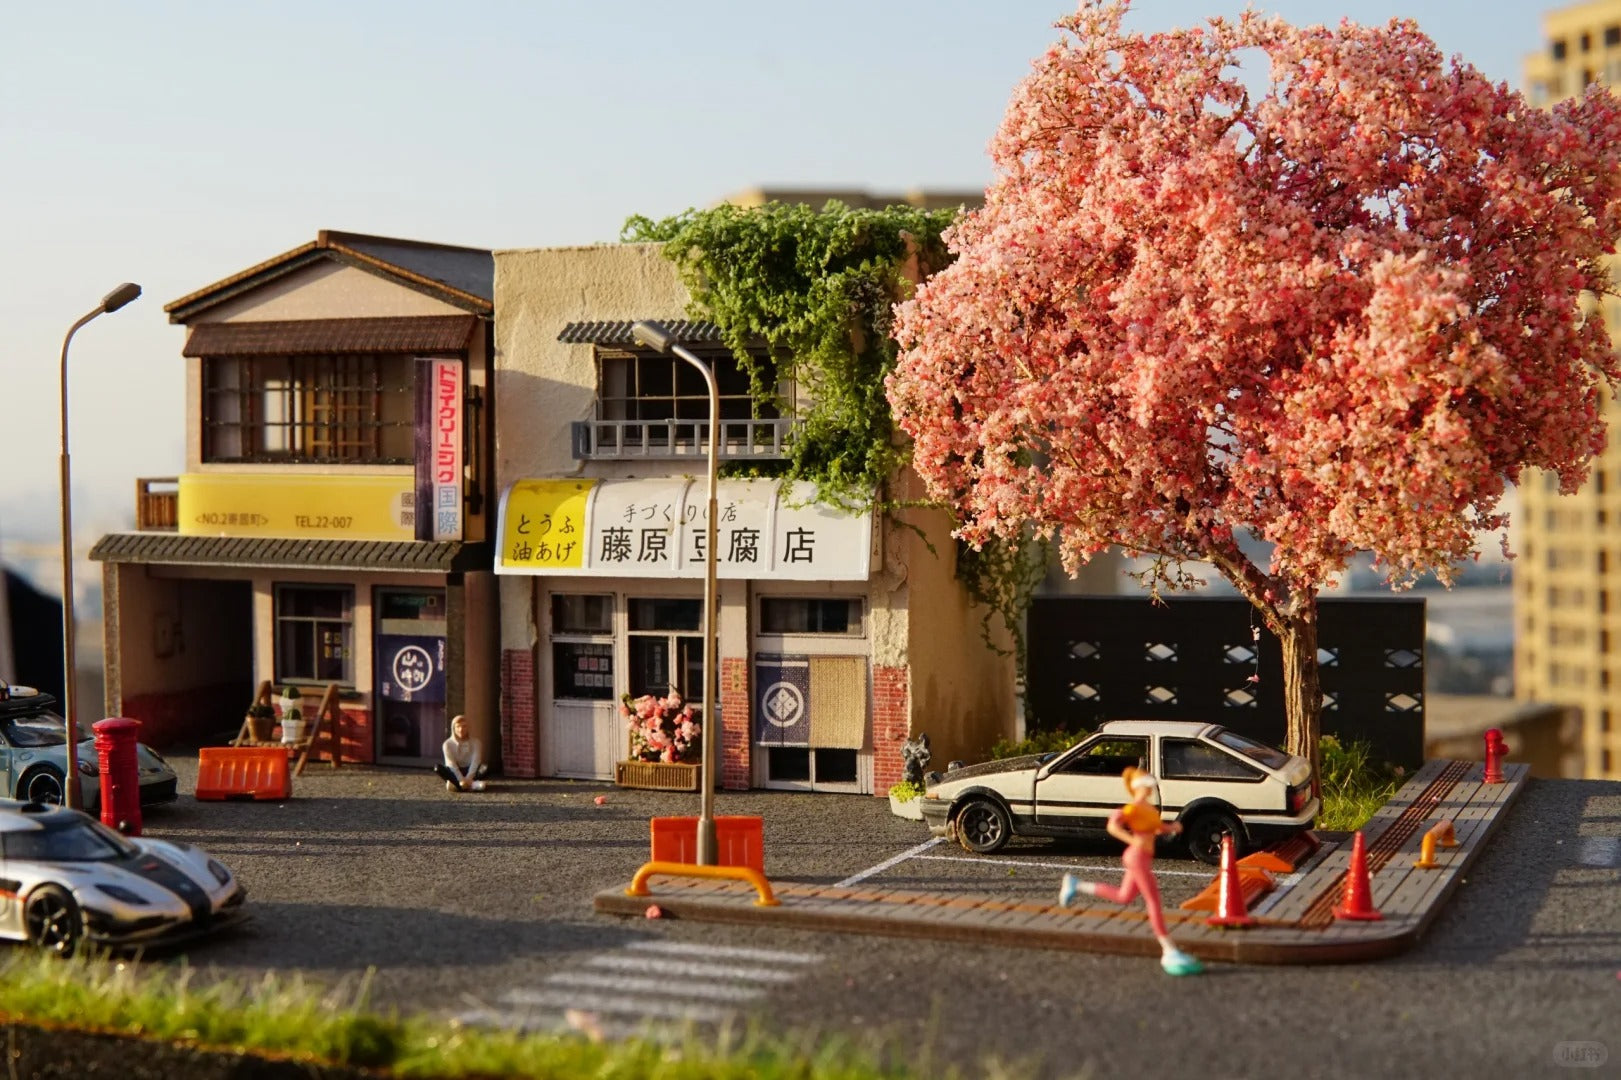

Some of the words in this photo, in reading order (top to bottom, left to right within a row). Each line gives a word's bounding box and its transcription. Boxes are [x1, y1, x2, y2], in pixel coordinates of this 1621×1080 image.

[438, 486, 458, 534] 国際
[295, 515, 353, 528] TEL.22-007
[517, 514, 575, 535] とうふ
[512, 541, 577, 561] 油あげ
[600, 526, 816, 563] 藤原豆腐店
